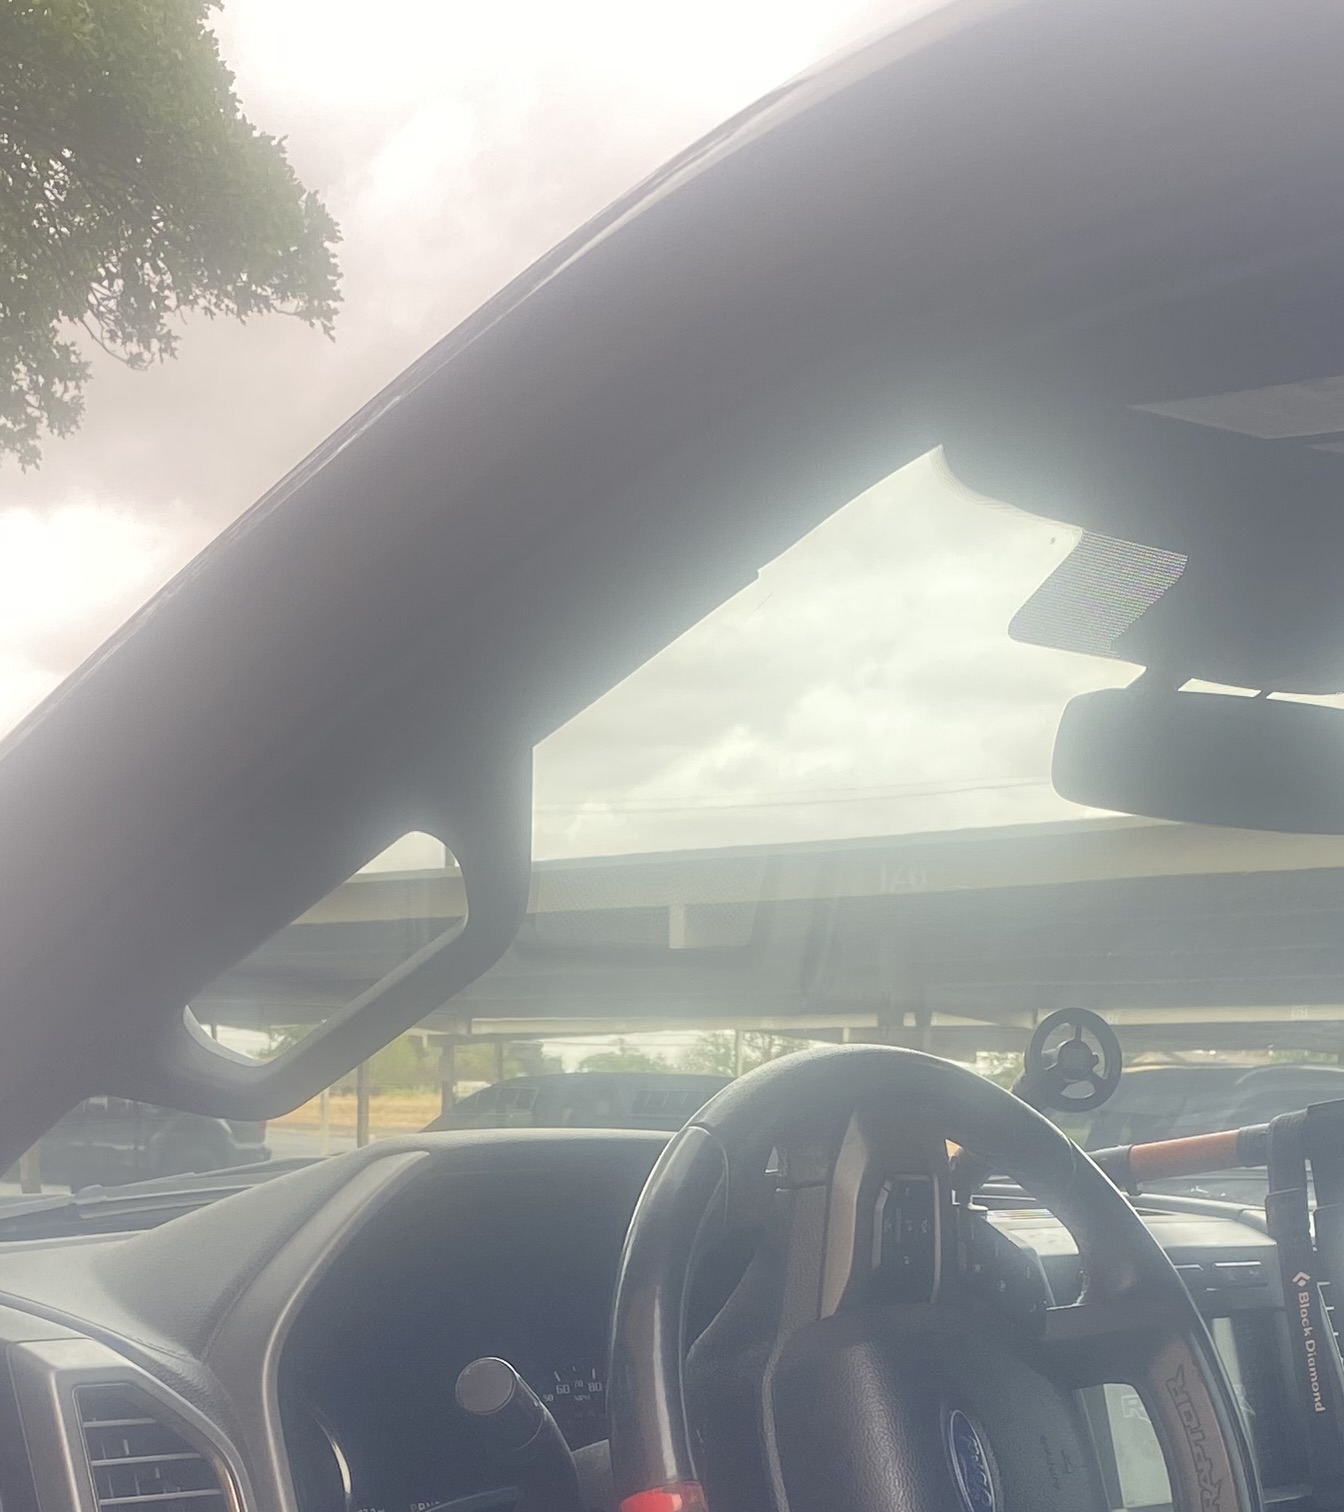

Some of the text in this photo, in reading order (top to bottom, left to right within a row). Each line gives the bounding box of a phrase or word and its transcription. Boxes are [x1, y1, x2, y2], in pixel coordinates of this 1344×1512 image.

[1298, 1291, 1326, 1412] Black Diamond
[556, 1383, 571, 1394] 60
[588, 1382, 602, 1392] 80
[958, 1434, 992, 1507] Ford
